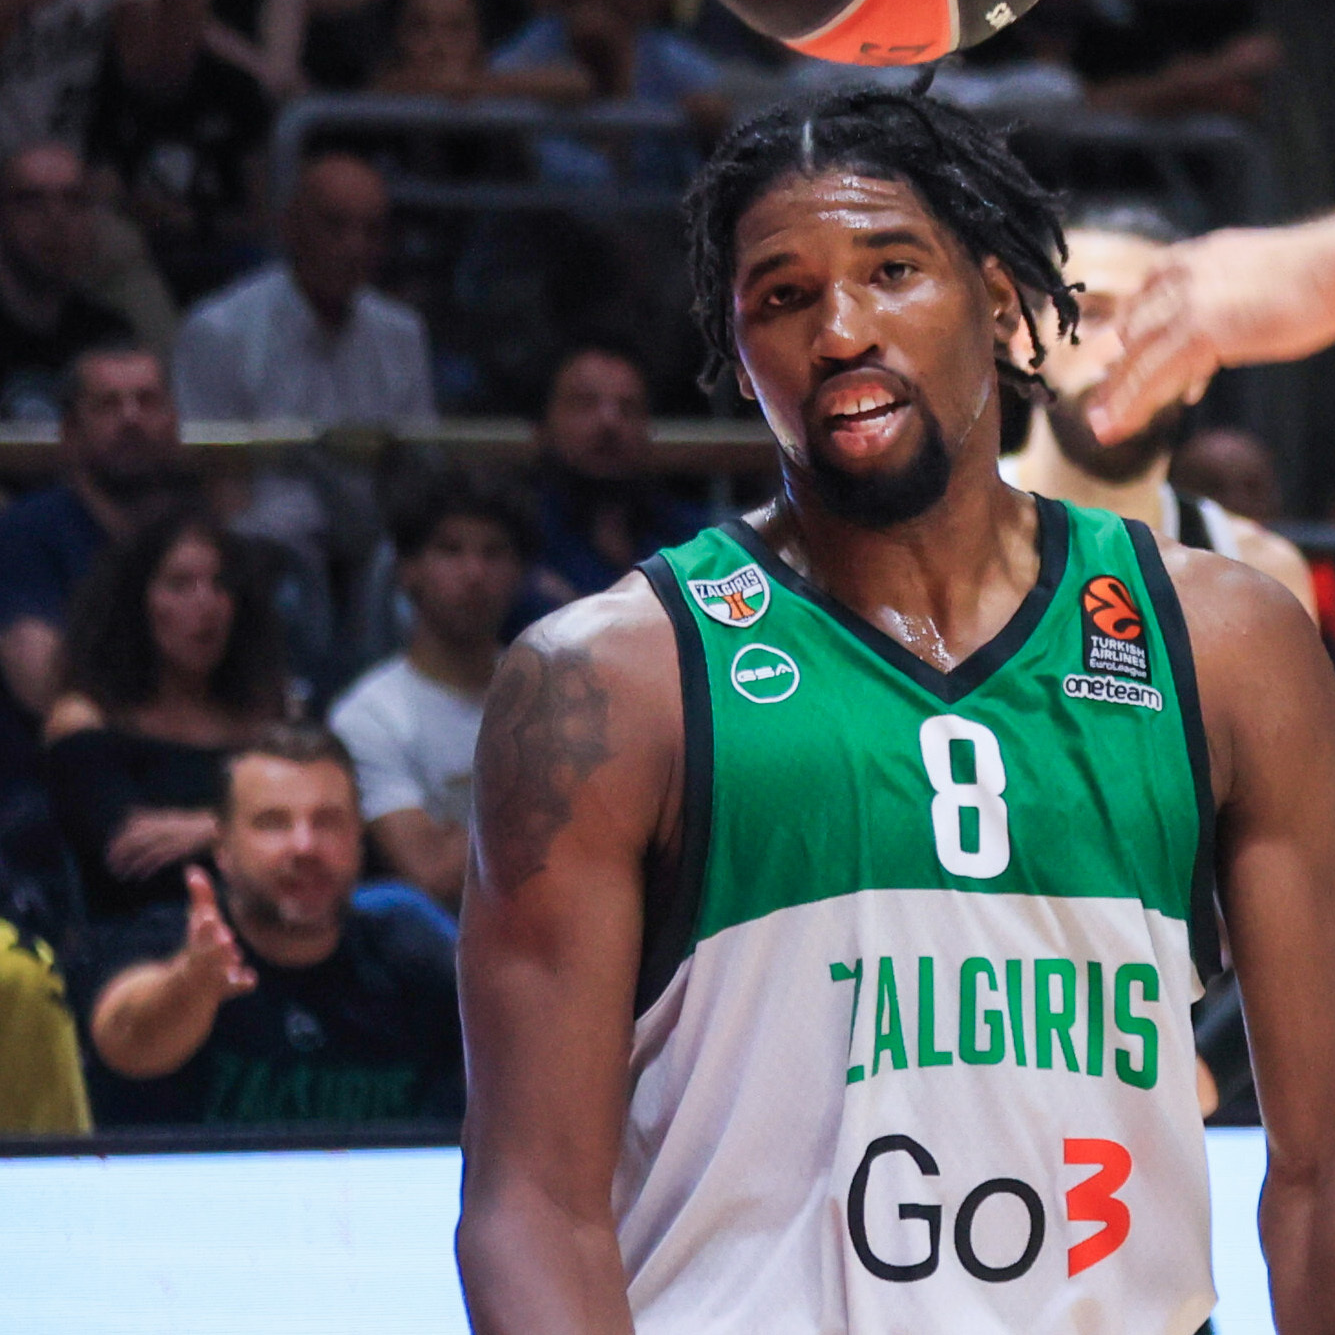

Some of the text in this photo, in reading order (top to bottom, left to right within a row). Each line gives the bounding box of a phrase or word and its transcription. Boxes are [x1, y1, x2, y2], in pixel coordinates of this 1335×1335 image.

[1090, 635, 1146, 658] TURKISH
[1090, 647, 1147, 669] AIRLINES
[919, 713, 1010, 879] 8
